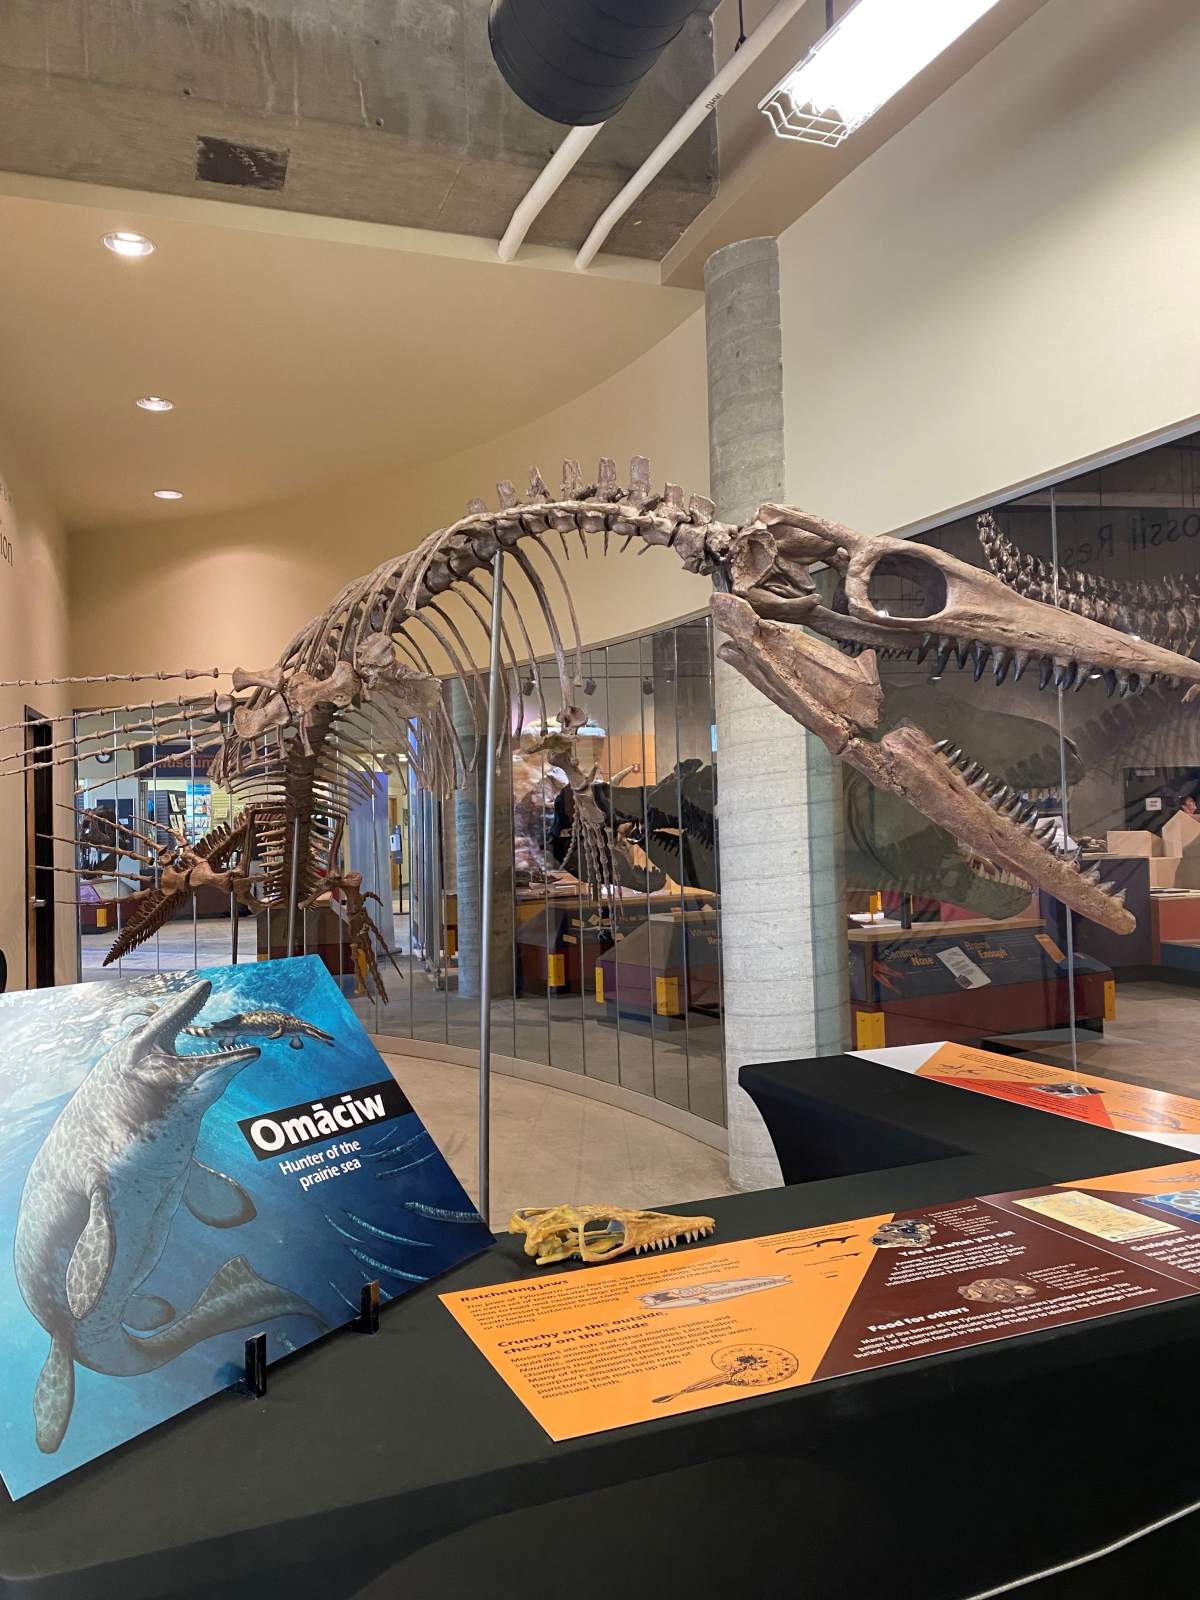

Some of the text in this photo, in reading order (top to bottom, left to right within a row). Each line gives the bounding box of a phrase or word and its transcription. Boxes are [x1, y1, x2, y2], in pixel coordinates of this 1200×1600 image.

[705, 93, 722, 109] DHW
[278, 1140, 362, 1176] Hunter of the
[299, 1158, 362, 1192] prairie sea
[945, 1239, 975, 1247] what
[461, 1280, 568, 1302] Ratcheting jaws
[497, 1333, 560, 1347] Crunchy
[612, 1312, 669, 1324] outside,
[868, 1320, 905, 1331] Food
[927, 1308, 970, 1319] others
[504, 1342, 553, 1354] chewy
[605, 1323, 649, 1334] inside
